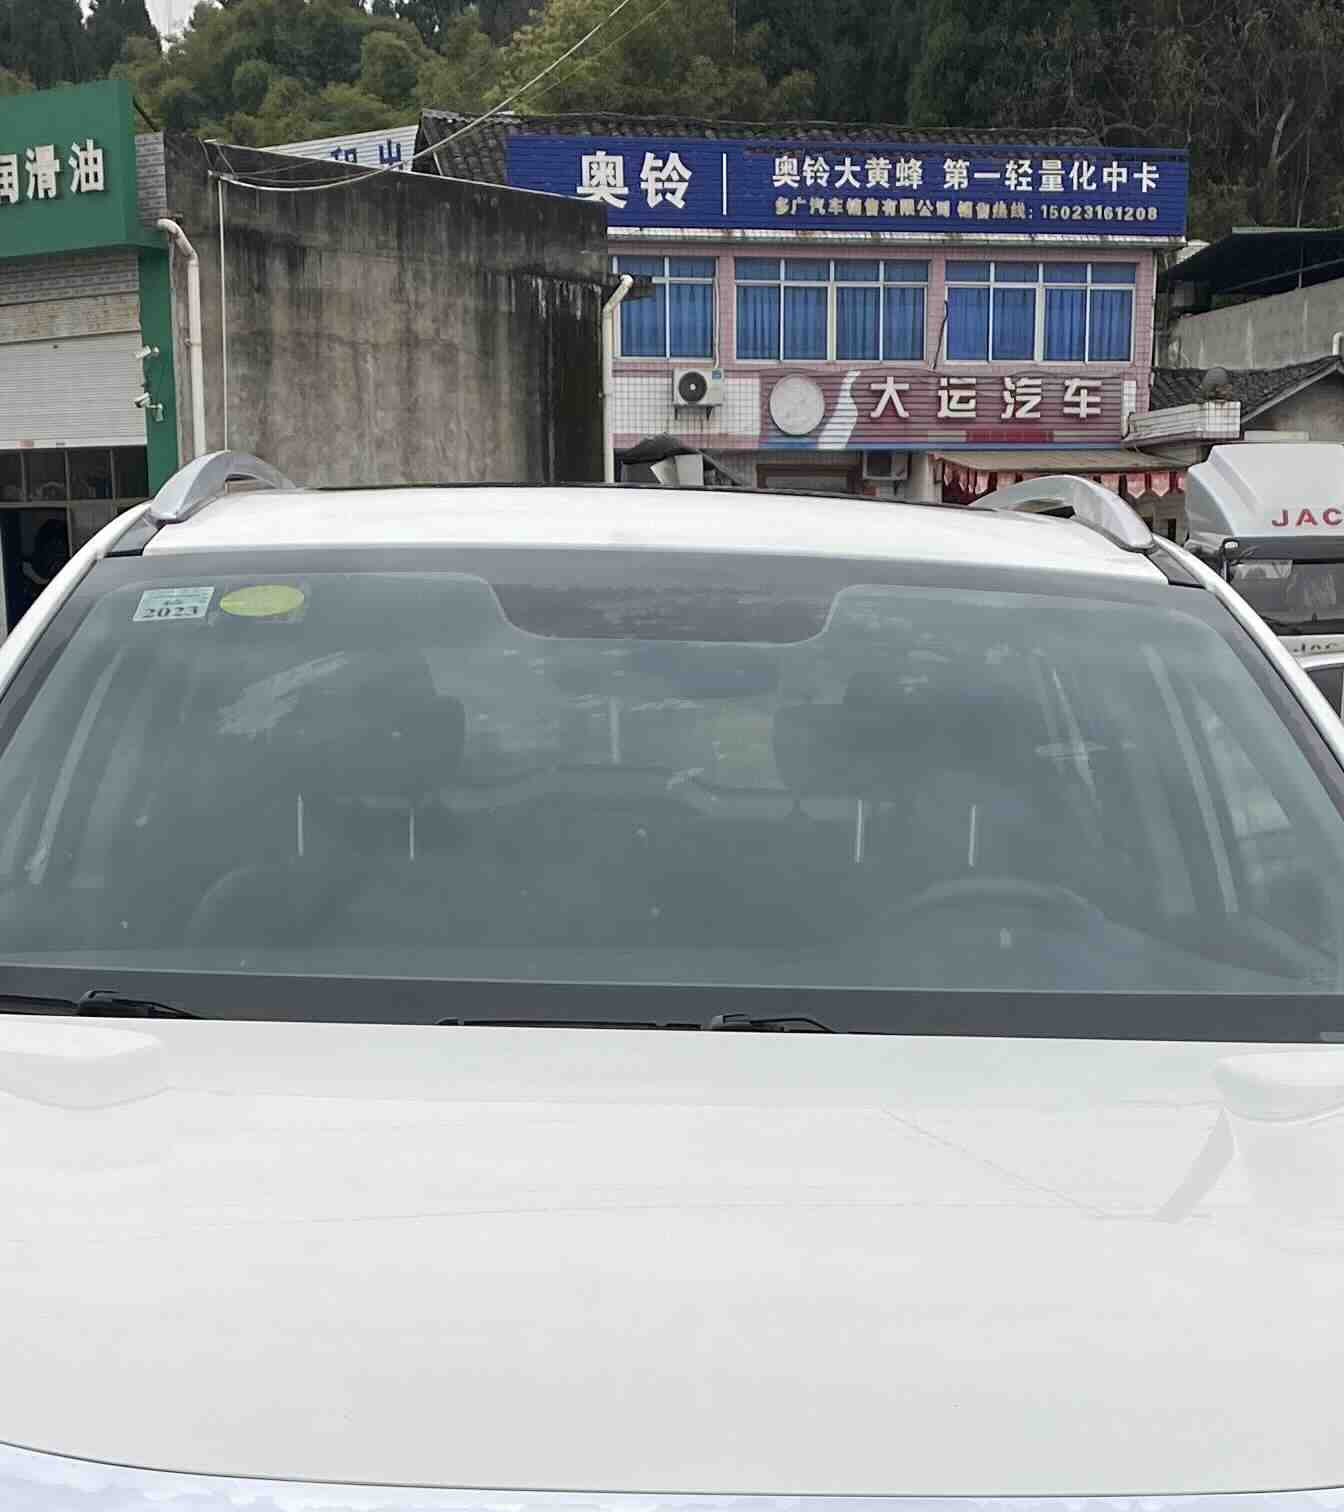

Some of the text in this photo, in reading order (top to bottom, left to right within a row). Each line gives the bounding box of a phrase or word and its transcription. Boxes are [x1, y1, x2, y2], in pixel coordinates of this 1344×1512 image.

[577, 151, 692, 209] 奥铃
[772, 157, 1160, 193] 奥铃大黄蜂 第一轻量化中卡
[869, 375, 1103, 419] 大运汽车
[1271, 508, 1343, 528] JAC
